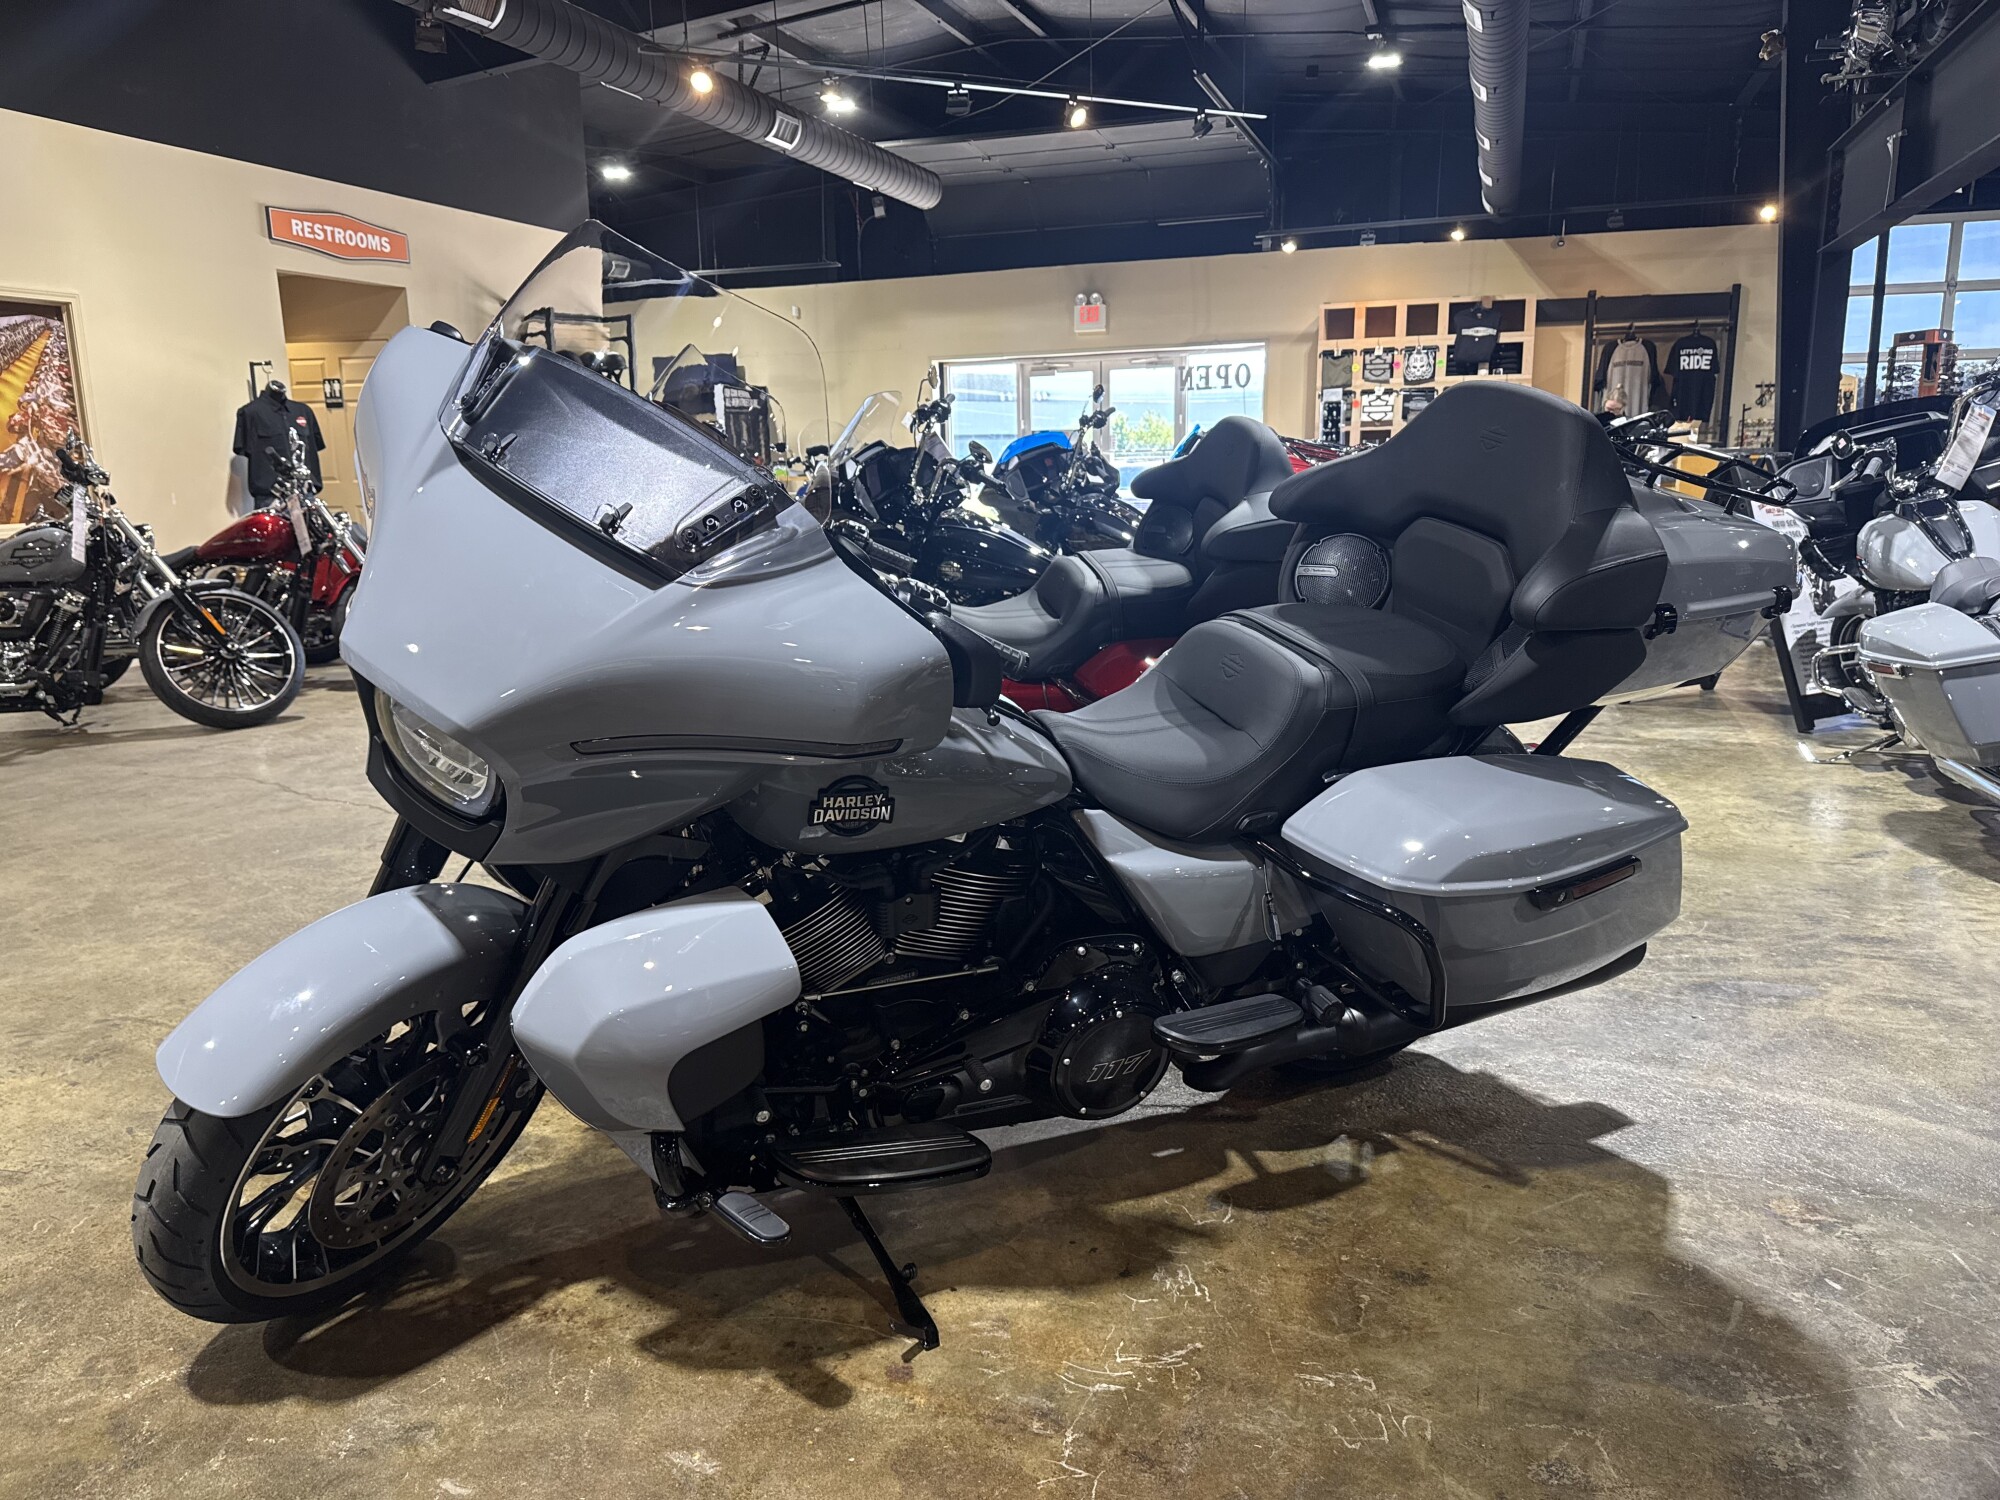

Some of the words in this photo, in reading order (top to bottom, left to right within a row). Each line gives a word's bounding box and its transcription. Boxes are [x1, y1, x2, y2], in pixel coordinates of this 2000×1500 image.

[291, 218, 392, 253] RESTROOMS
[1680, 356, 1712, 370] RIDE
[813, 805, 891, 824] DAVIDSON
[1086, 1049, 1152, 1083] 117
